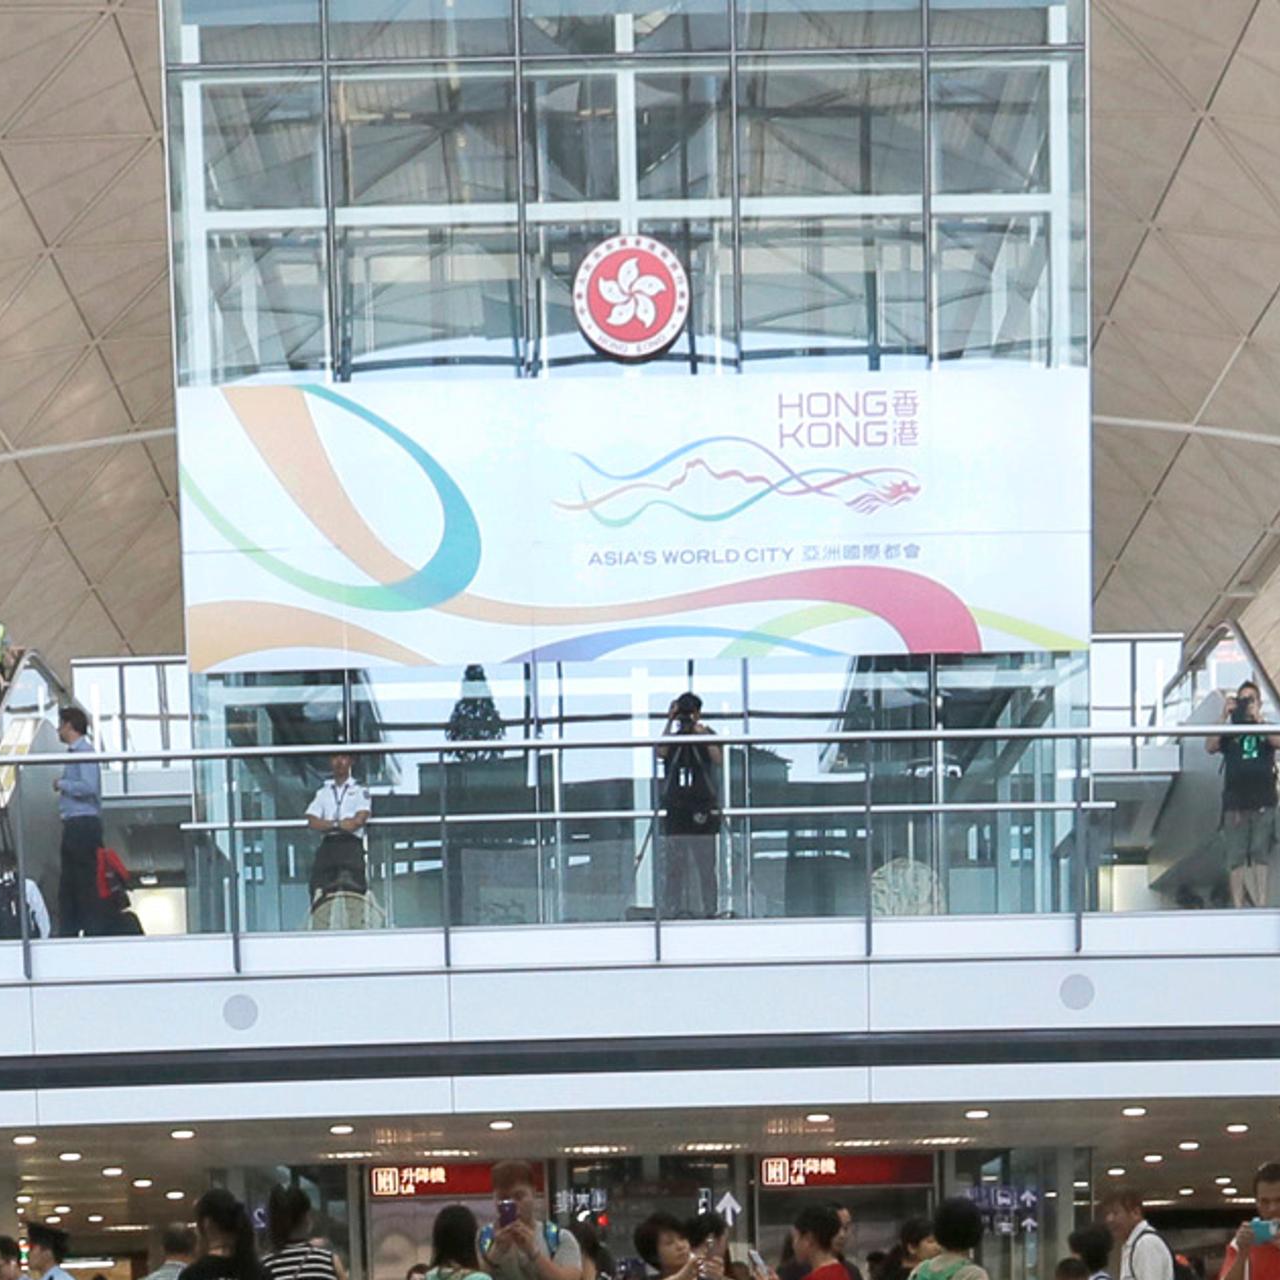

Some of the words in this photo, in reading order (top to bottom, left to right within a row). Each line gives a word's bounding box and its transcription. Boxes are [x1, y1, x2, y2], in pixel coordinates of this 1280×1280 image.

[778, 390, 888, 419] HONG
[779, 420, 888, 449] KONG
[587, 550, 658, 567] ASIA'S
[662, 548, 740, 566] WORLD
[744, 547, 795, 563] CITY
